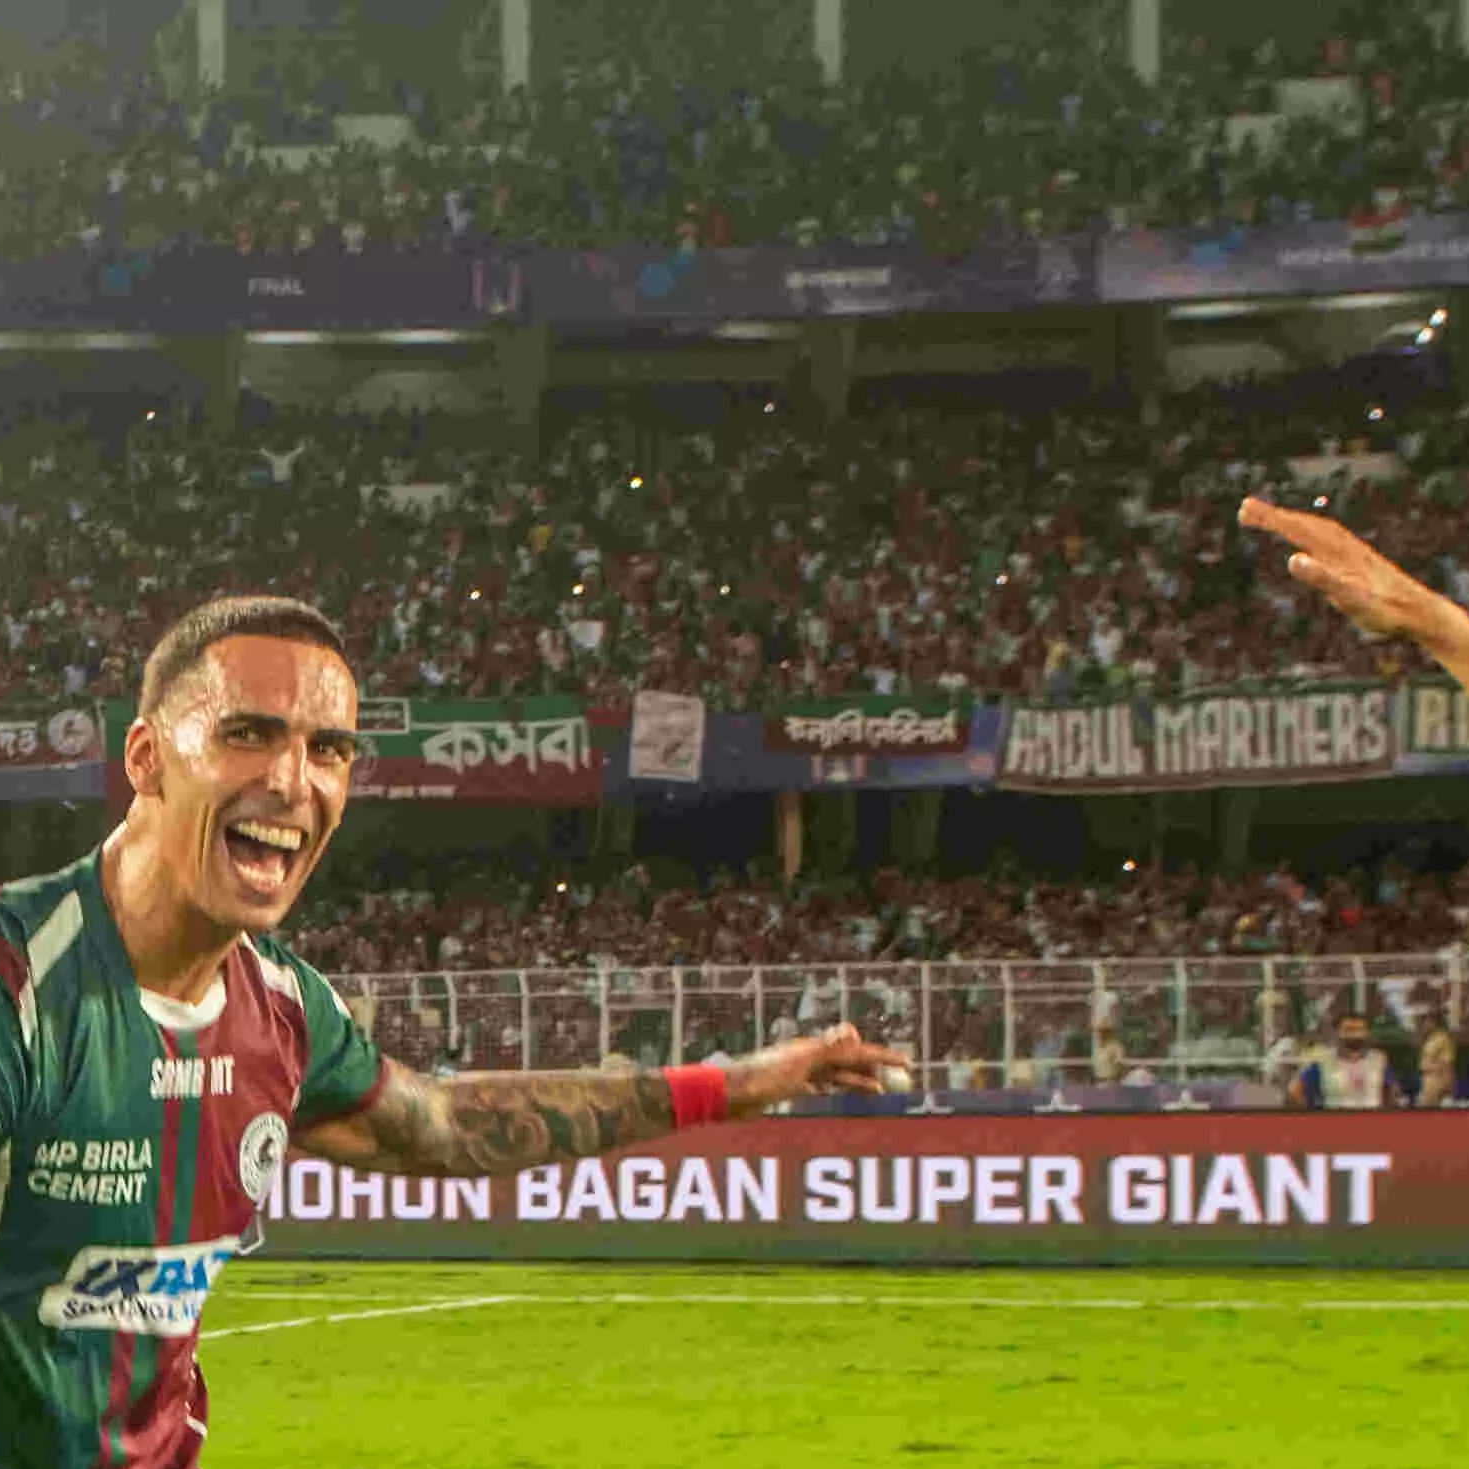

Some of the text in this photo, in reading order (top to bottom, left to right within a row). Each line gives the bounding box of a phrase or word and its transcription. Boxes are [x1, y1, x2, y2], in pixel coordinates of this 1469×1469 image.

[1153, 690, 1387, 774] MARINERS
[82, 1138, 153, 1170] BIRLA
[27, 1169, 148, 1206] CEMENT
[516, 1156, 778, 1221] BAGAN
[804, 1155, 1082, 1223] SUPER
[1109, 1153, 1391, 1224] GIANT
